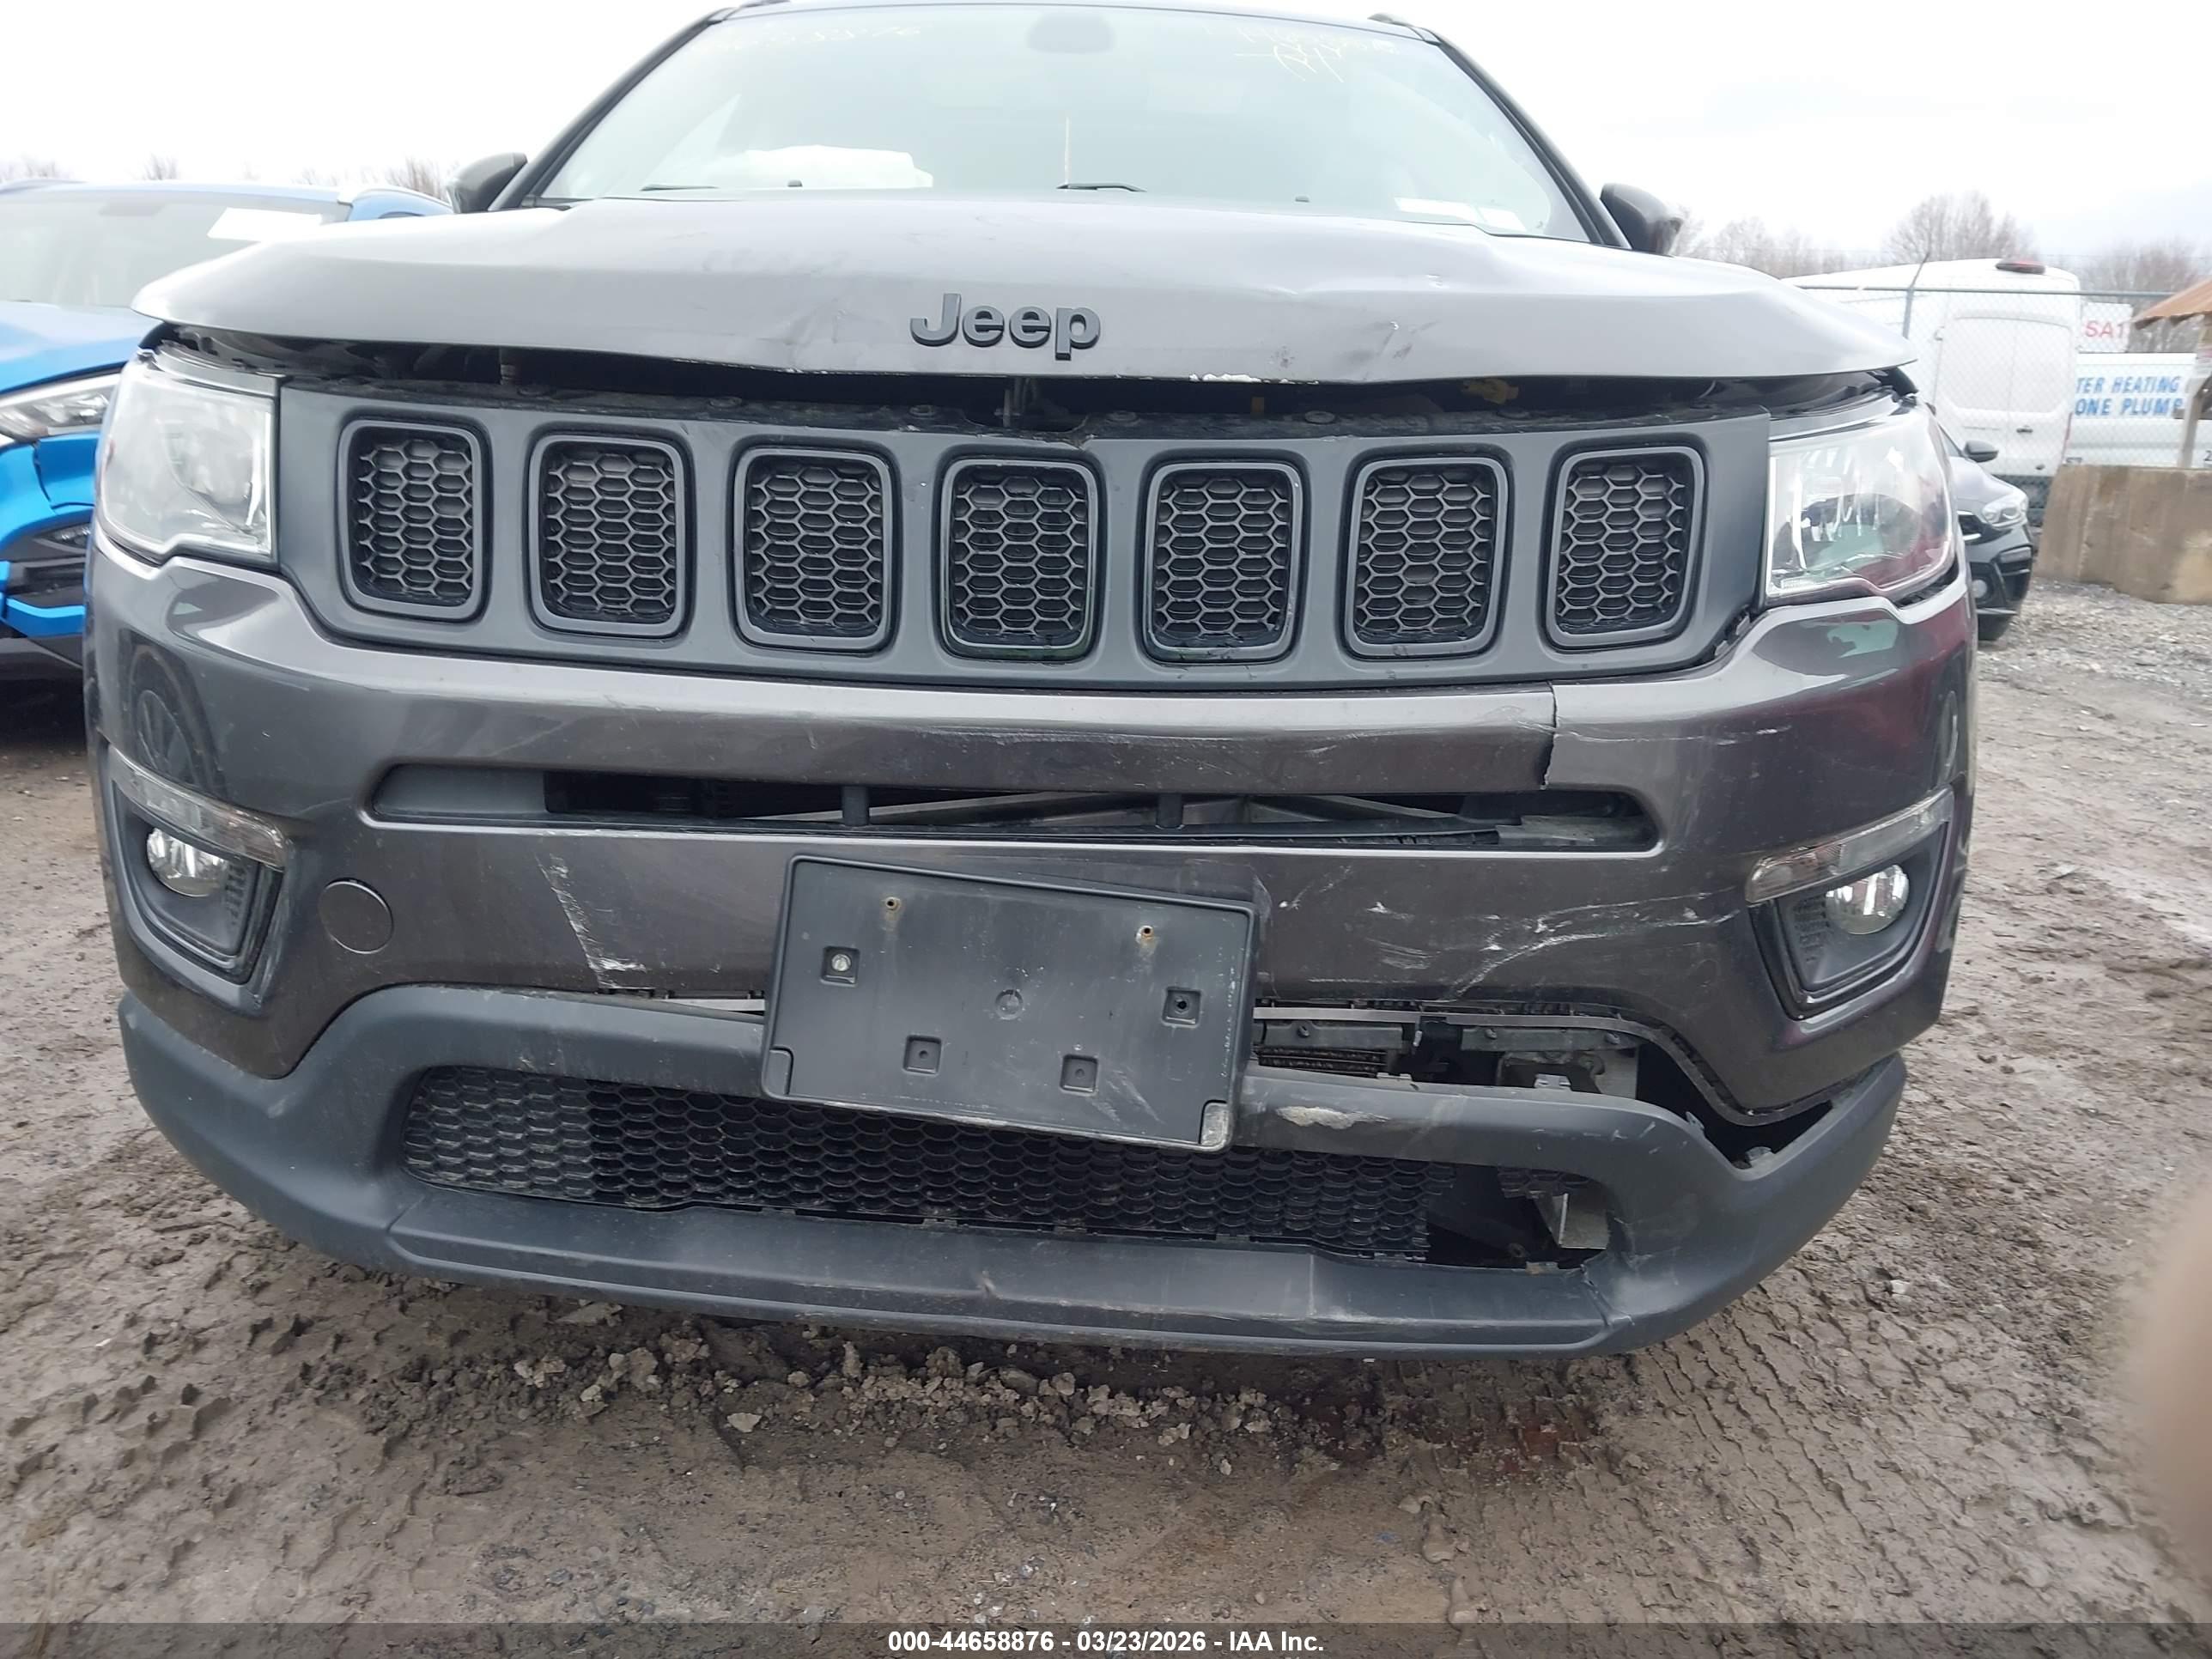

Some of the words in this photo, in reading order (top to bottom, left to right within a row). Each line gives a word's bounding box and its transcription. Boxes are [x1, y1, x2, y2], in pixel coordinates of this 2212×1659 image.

[909, 293, 1101, 361] Jeep
[2111, 376, 2181, 393] HEATING
[2075, 398, 2112, 416] ONE
